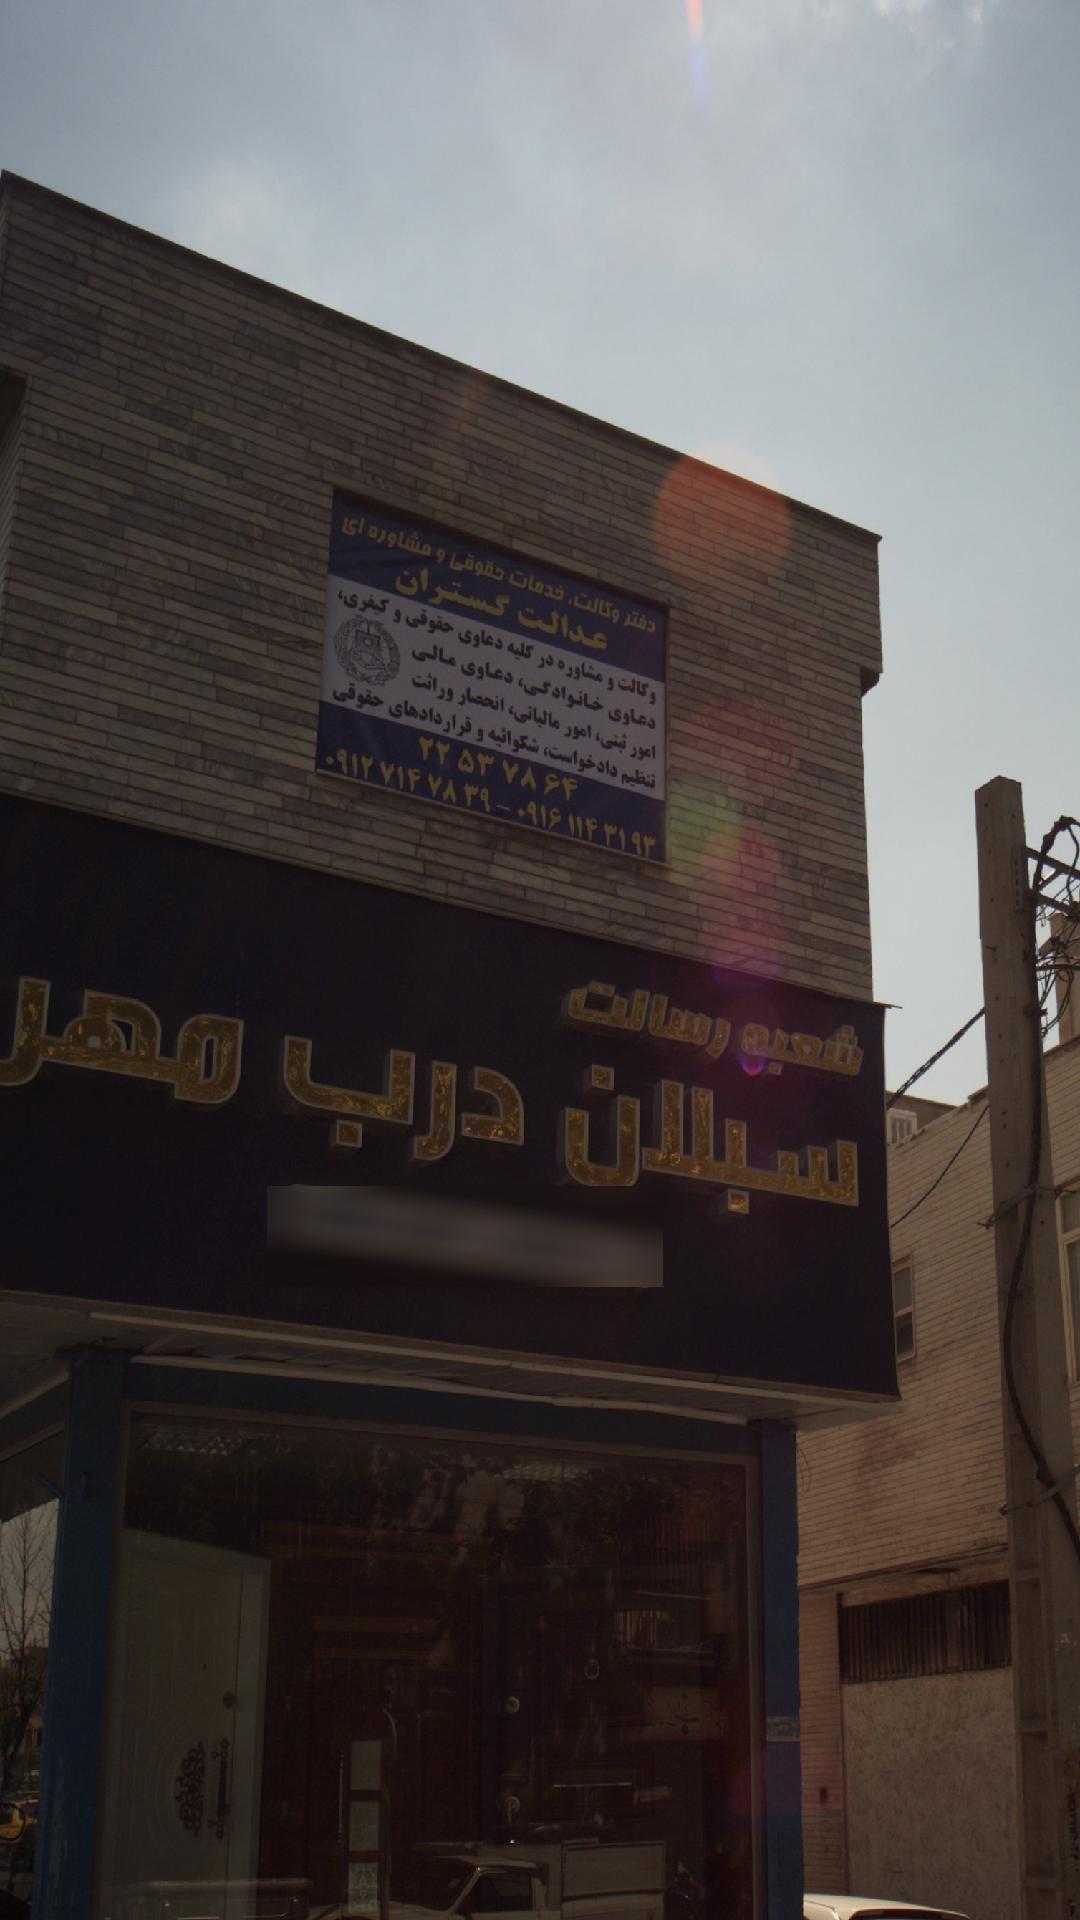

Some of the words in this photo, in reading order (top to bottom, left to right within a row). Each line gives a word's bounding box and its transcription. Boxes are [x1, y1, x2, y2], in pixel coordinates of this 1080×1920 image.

[341, 517, 366, 536] ای
[368, 525, 432, 556] مشاوره
[436, 550, 446, 564] و
[449, 551, 505, 581] حقوقی
[395, 568, 511, 616] گستران
[508, 571, 565, 600] خدمات
[393, 609, 401, 623] و
[405, 609, 454, 634] حقوقی
[623, 611, 657, 634] دفتر
[458, 630, 503, 650] دعاوی
[518, 607, 608, 650] عدالت
[412, 645, 456, 666] مالی
[507, 642, 534, 660] کلیه
[537, 655, 554, 668] در
[461, 662, 513, 683] دعاوی
[558, 660, 603, 682] مشاوره
[333, 683, 383, 709] حقوقی
[412, 673, 453, 701] وراثت
[606, 677, 614, 691] و
[618, 678, 656, 705] وکالت
[457, 687, 504, 712] انحصار
[389, 700, 472, 736] قراردادهای
[608, 708, 655, 730] دعاوی
[477, 729, 484, 742] و
[564, 725, 591, 739] امور
[630, 746, 656, 759] امور
[621, 769, 656, 788] تنظیم
[566, 980, 731, 1058] رسالت
[0, 976, 244, 1105] مهر
[742, 1024, 864, 1076] شعبه
[283, 1035, 524, 1161] درب
[562, 1063, 859, 1215] سبلان
